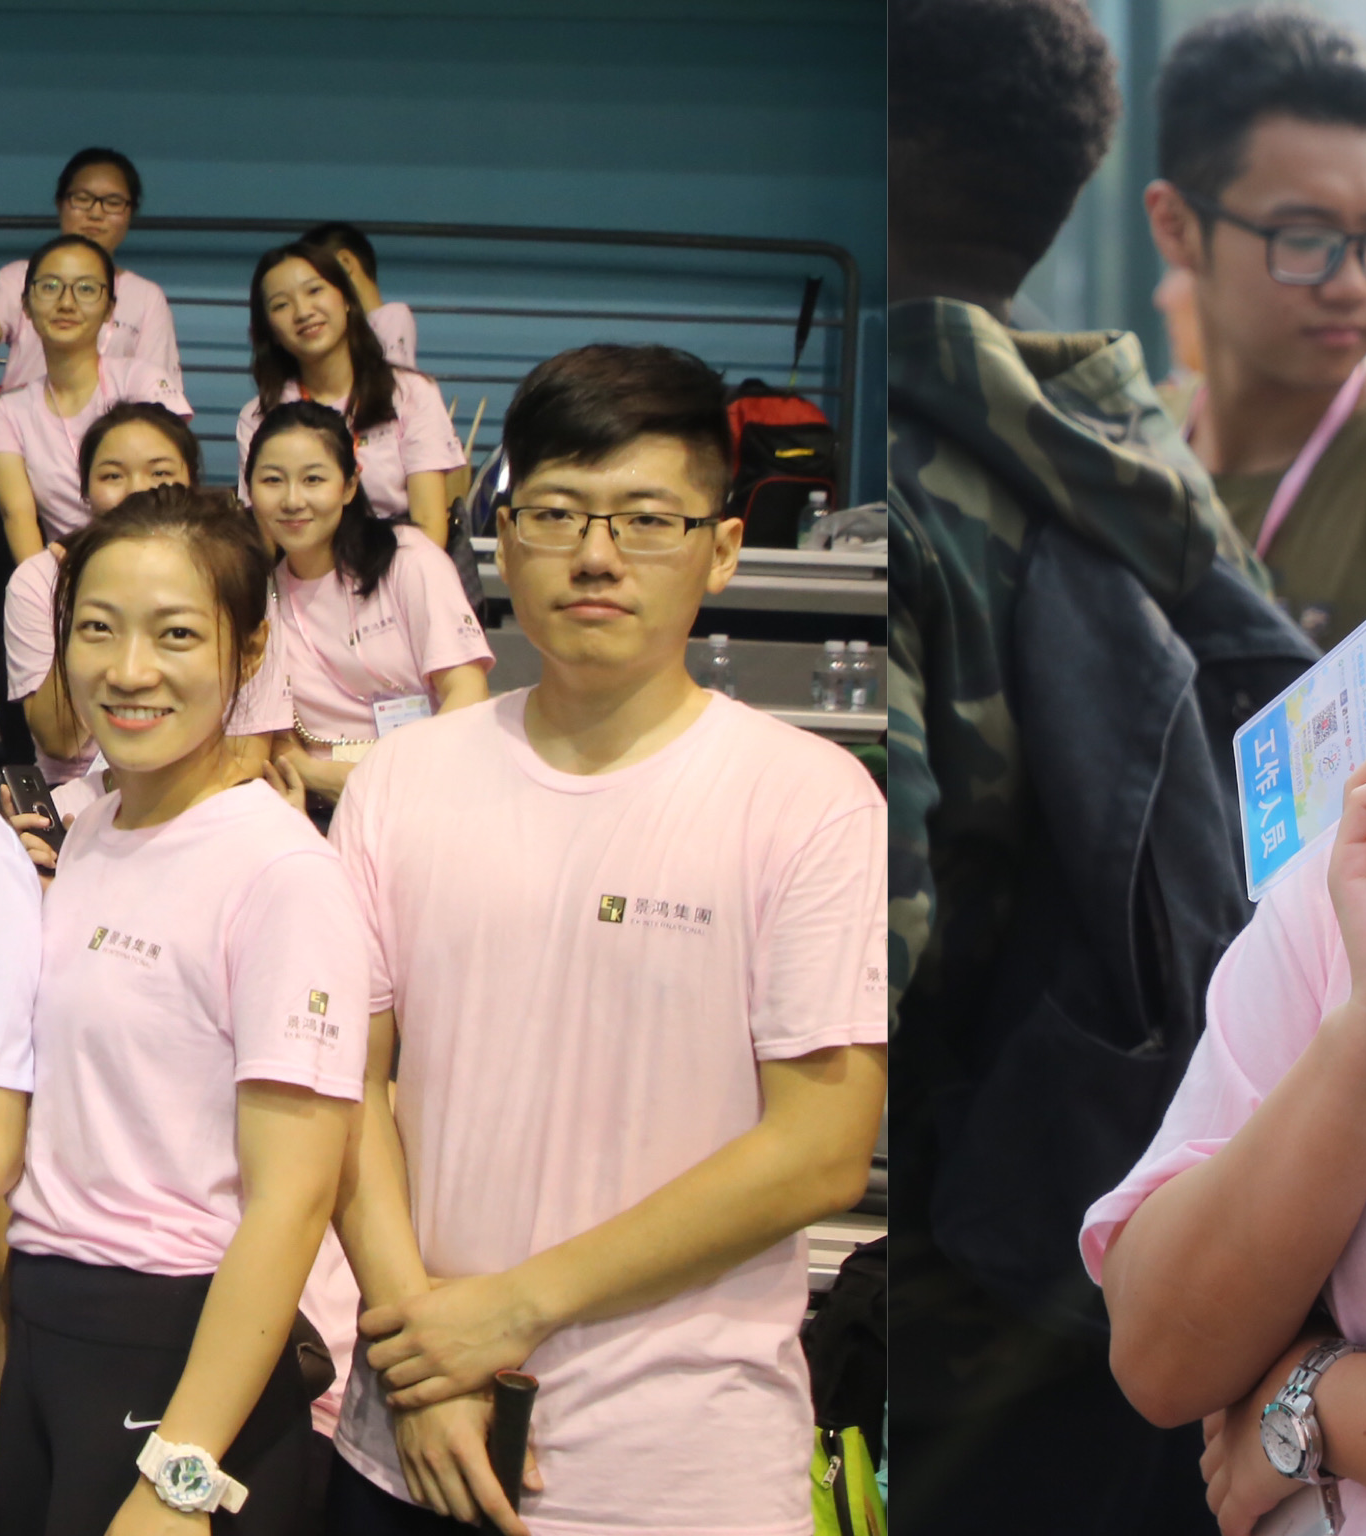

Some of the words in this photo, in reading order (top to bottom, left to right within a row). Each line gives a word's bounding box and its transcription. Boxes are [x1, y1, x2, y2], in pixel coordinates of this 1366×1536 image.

[1254, 728, 1286, 859] 工作人员
[635, 898, 712, 925] 景鴻集團
